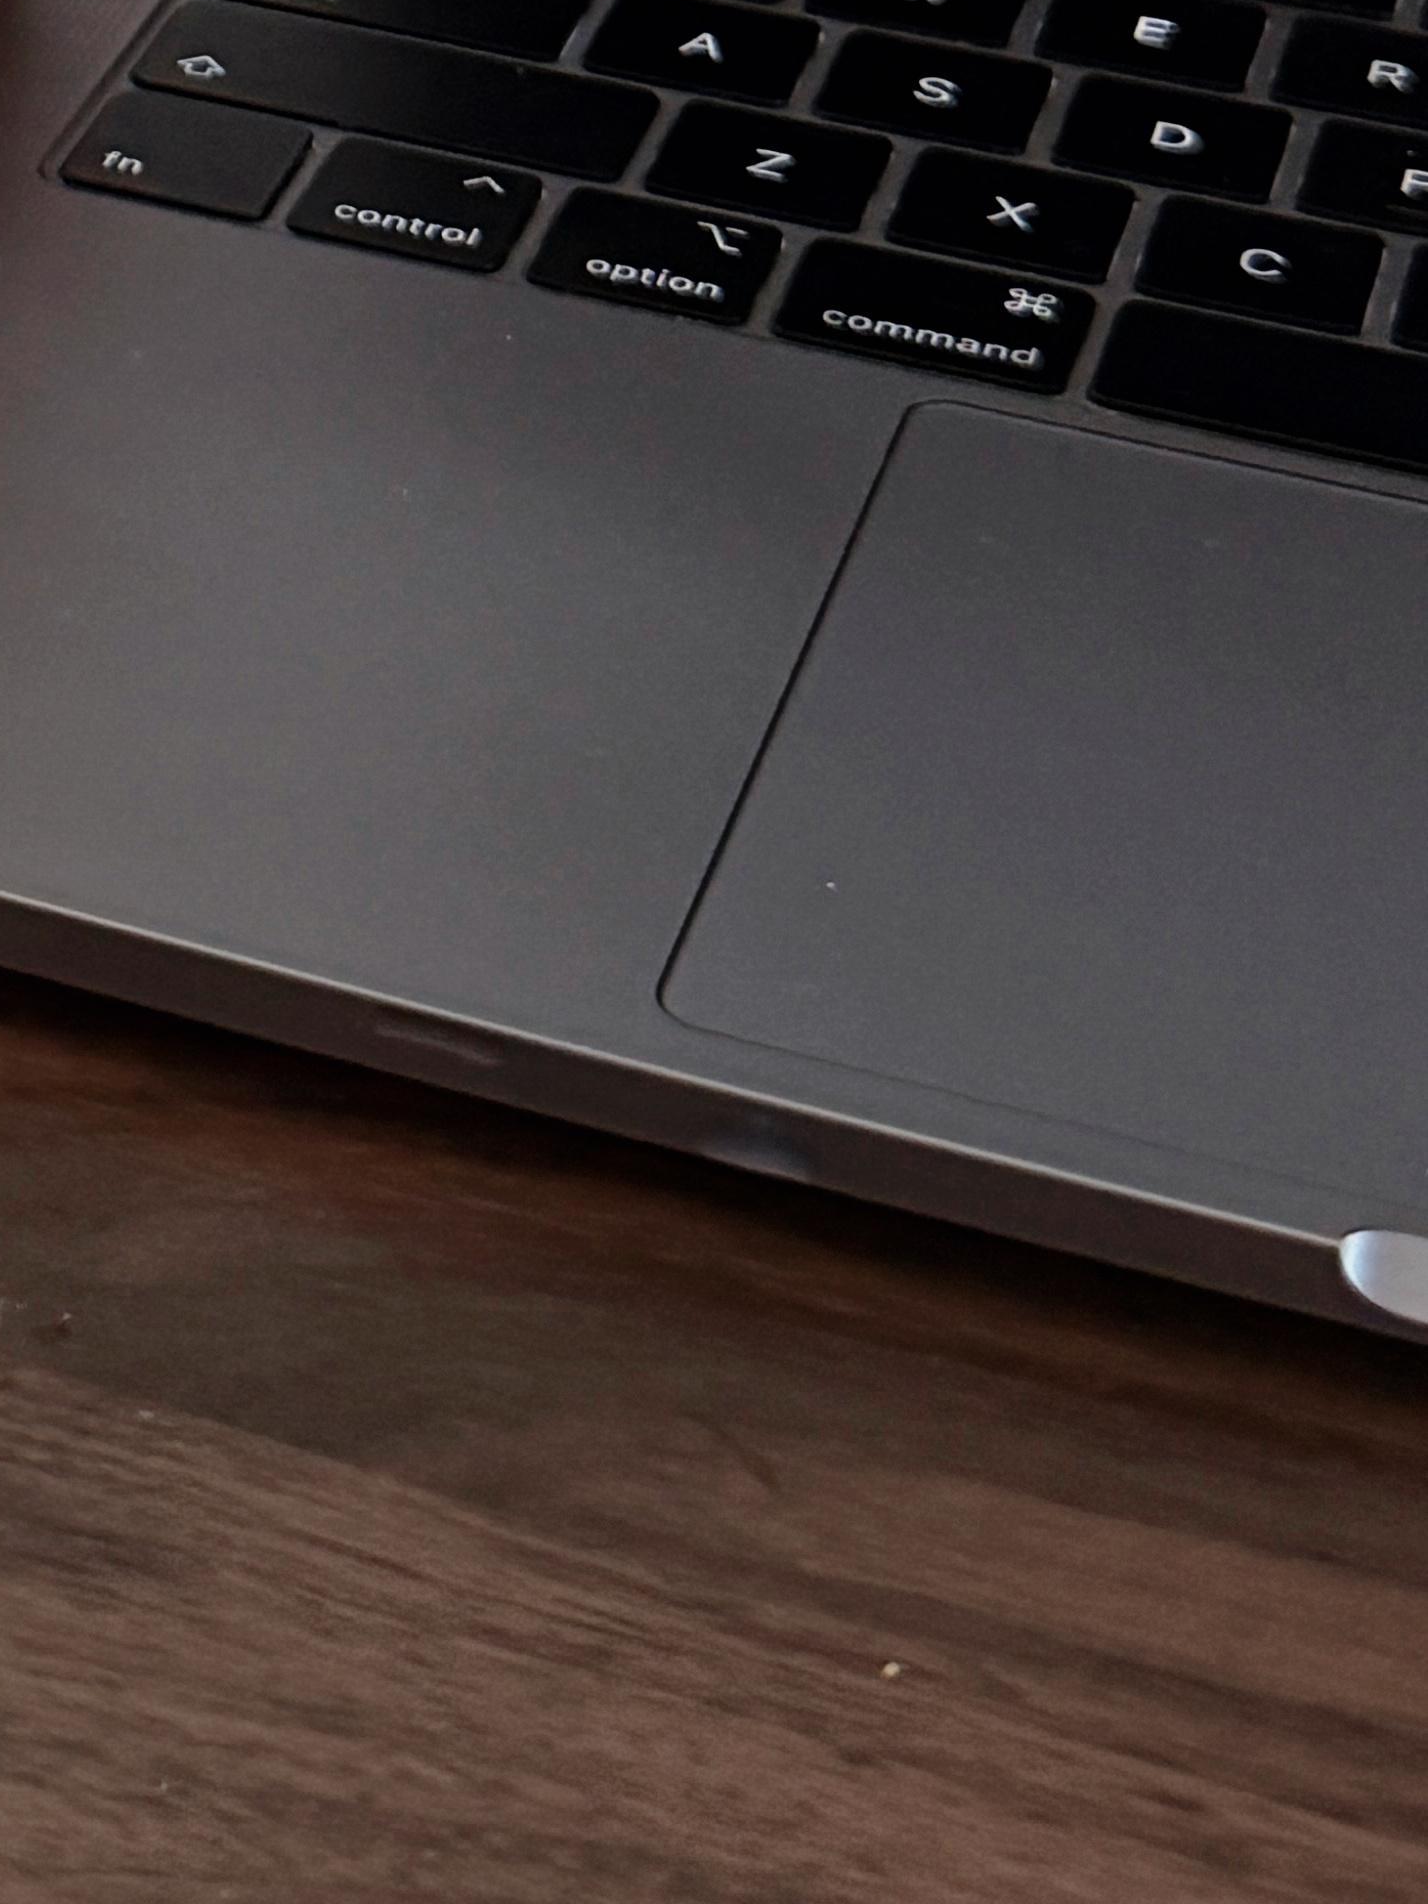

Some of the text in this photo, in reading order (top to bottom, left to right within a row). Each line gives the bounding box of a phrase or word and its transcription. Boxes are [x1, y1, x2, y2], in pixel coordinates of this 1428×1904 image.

[678, 32, 723, 63] A
[1133, 15, 1180, 49] E
[913, 76, 961, 108] S
[1366, 59, 1415, 92] R
[1149, 120, 1203, 154] D
[102, 149, 143, 176] fn
[745, 148, 796, 183] Z
[334, 201, 480, 248] control
[986, 195, 1039, 233] X
[586, 257, 725, 301] option
[1239, 248, 1290, 284] C
[822, 306, 1041, 368] command
